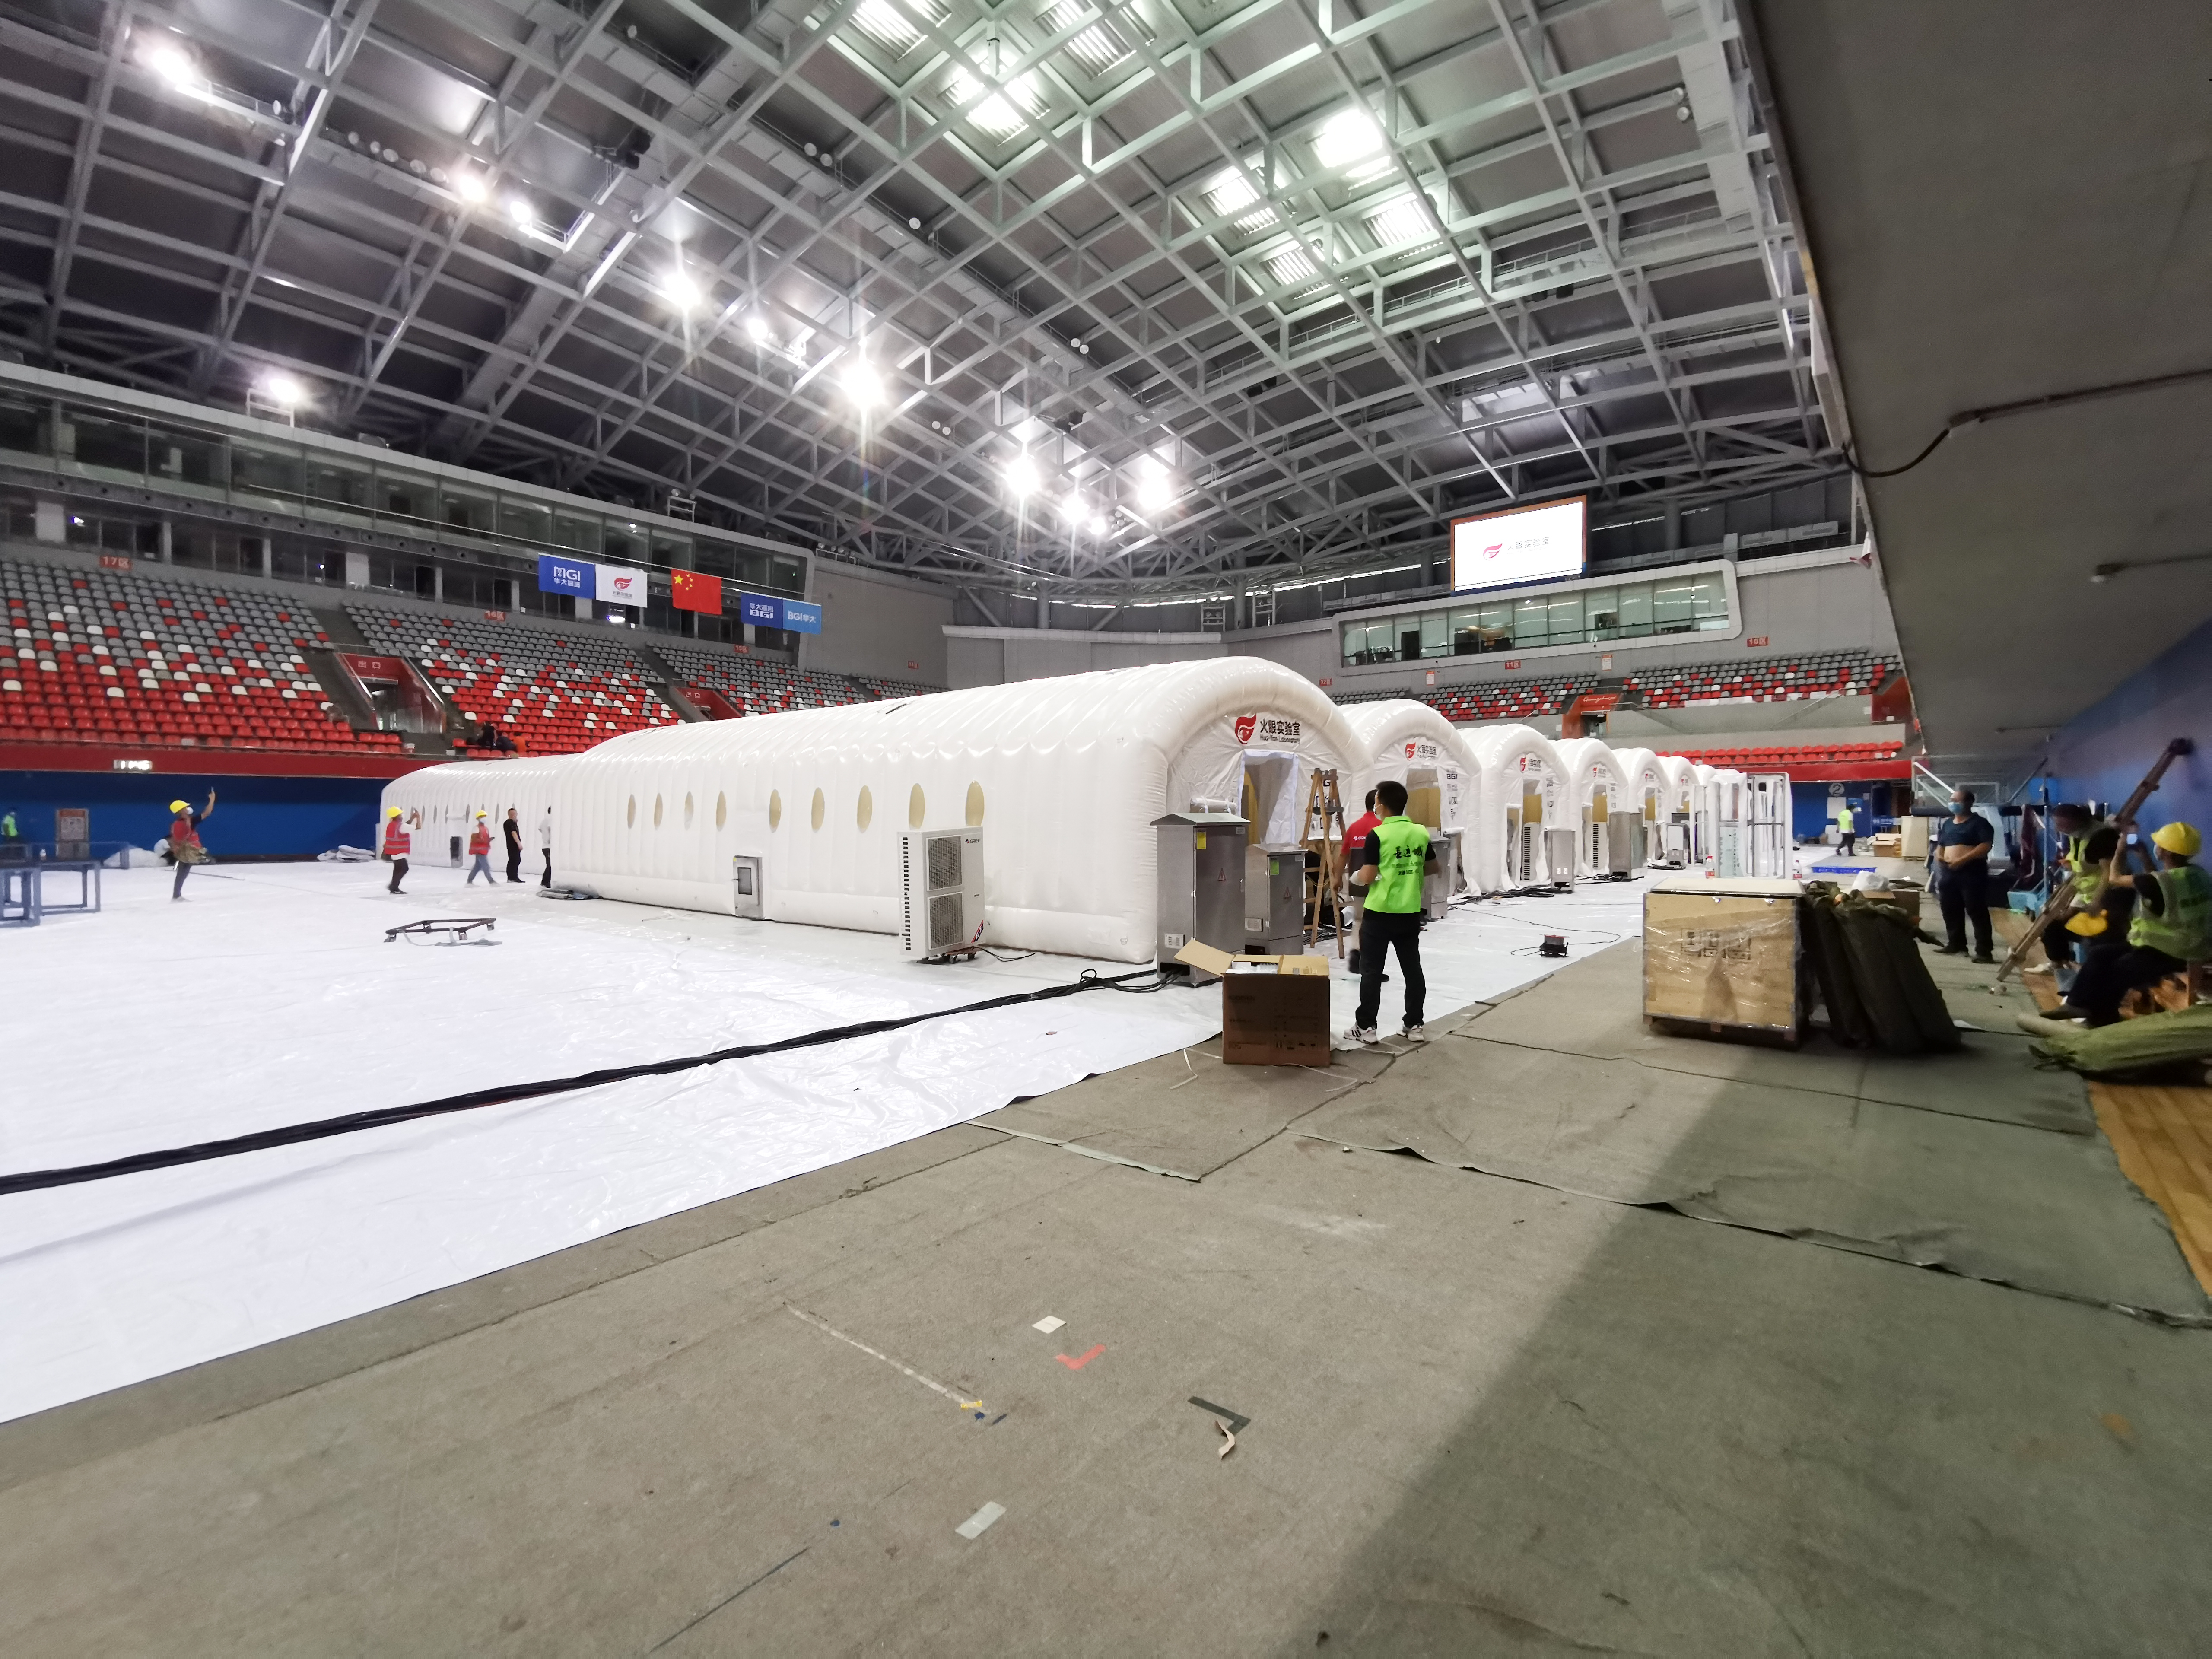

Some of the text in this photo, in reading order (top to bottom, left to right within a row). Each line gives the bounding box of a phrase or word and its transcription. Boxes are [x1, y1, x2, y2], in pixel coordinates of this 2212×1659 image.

[553, 566, 581, 581] MGI
[749, 609, 774, 619] BGI
[358, 660, 381, 670] 出口
[1260, 718, 1300, 736] 火眼实验室
[1833, 784, 1841, 795] 2
